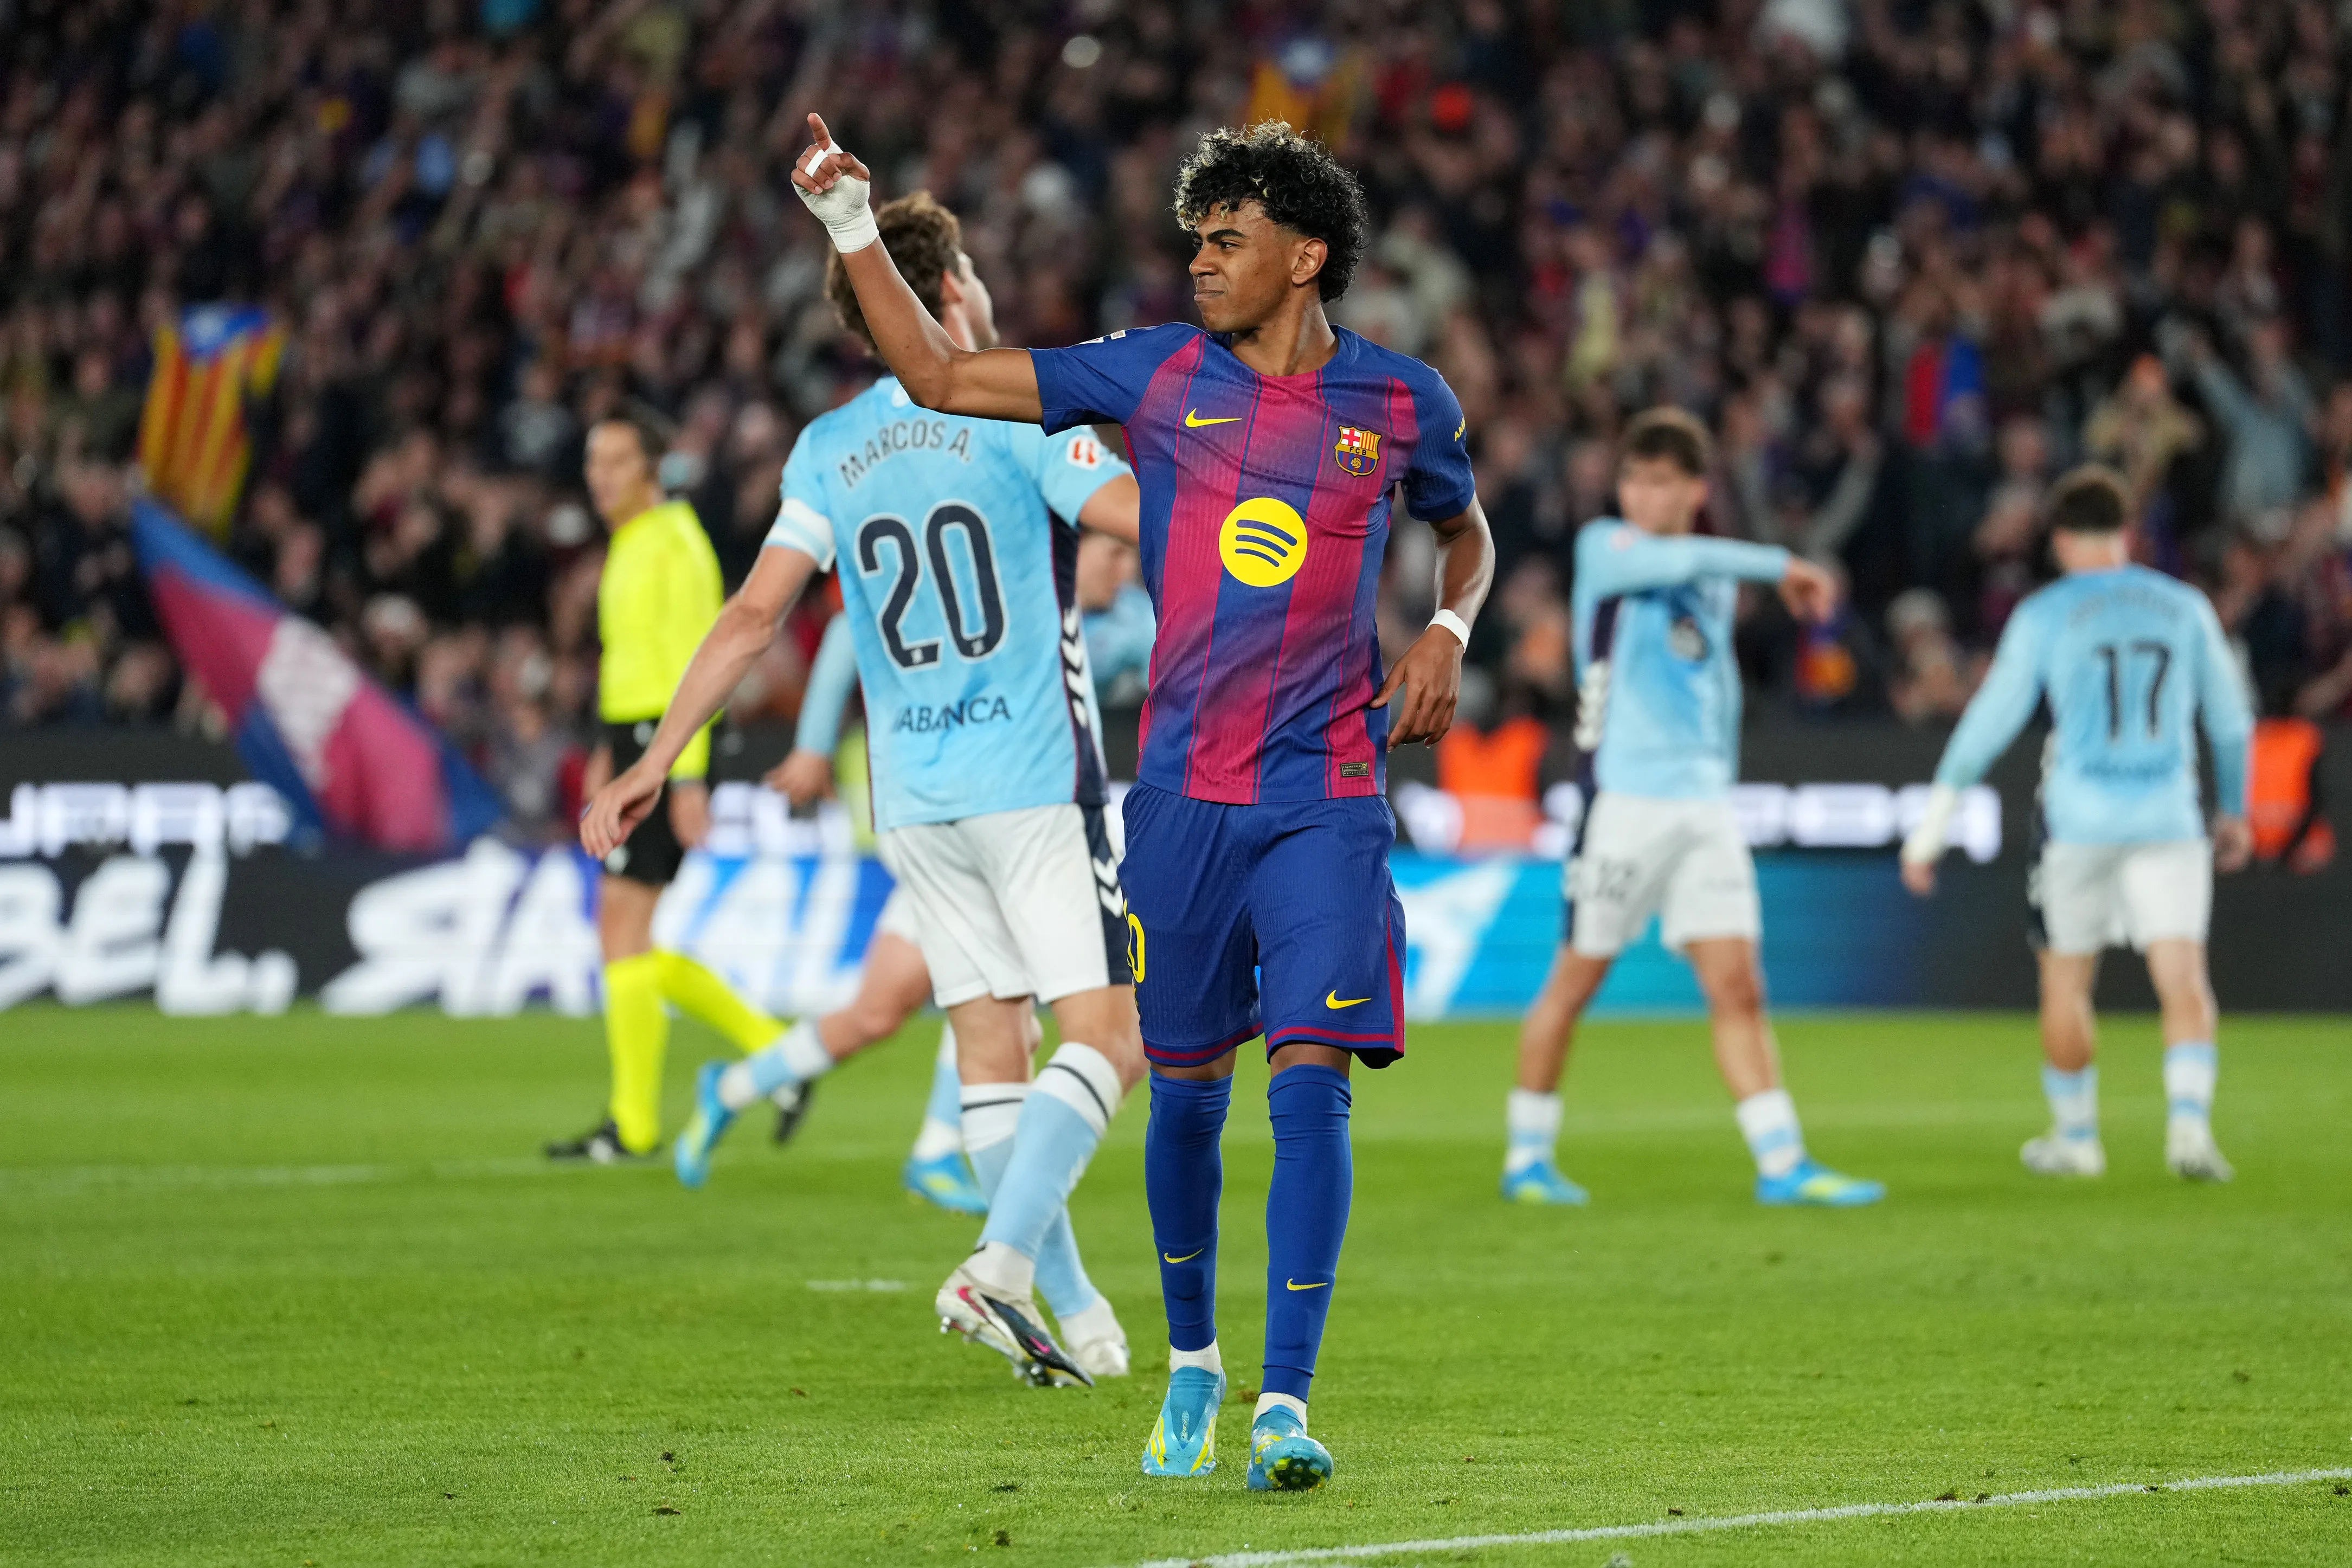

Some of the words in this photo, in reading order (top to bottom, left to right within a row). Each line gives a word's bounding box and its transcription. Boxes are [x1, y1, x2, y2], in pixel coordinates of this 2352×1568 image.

[840, 419, 946, 488] MARCOS
[947, 428, 971, 462] A.
[1349, 446, 1366, 455] FCB
[856, 502, 1007, 669] 20
[895, 696, 1012, 732] ABANCA
[2094, 640, 2172, 741] 17
[1123, 898, 1145, 983] 0
